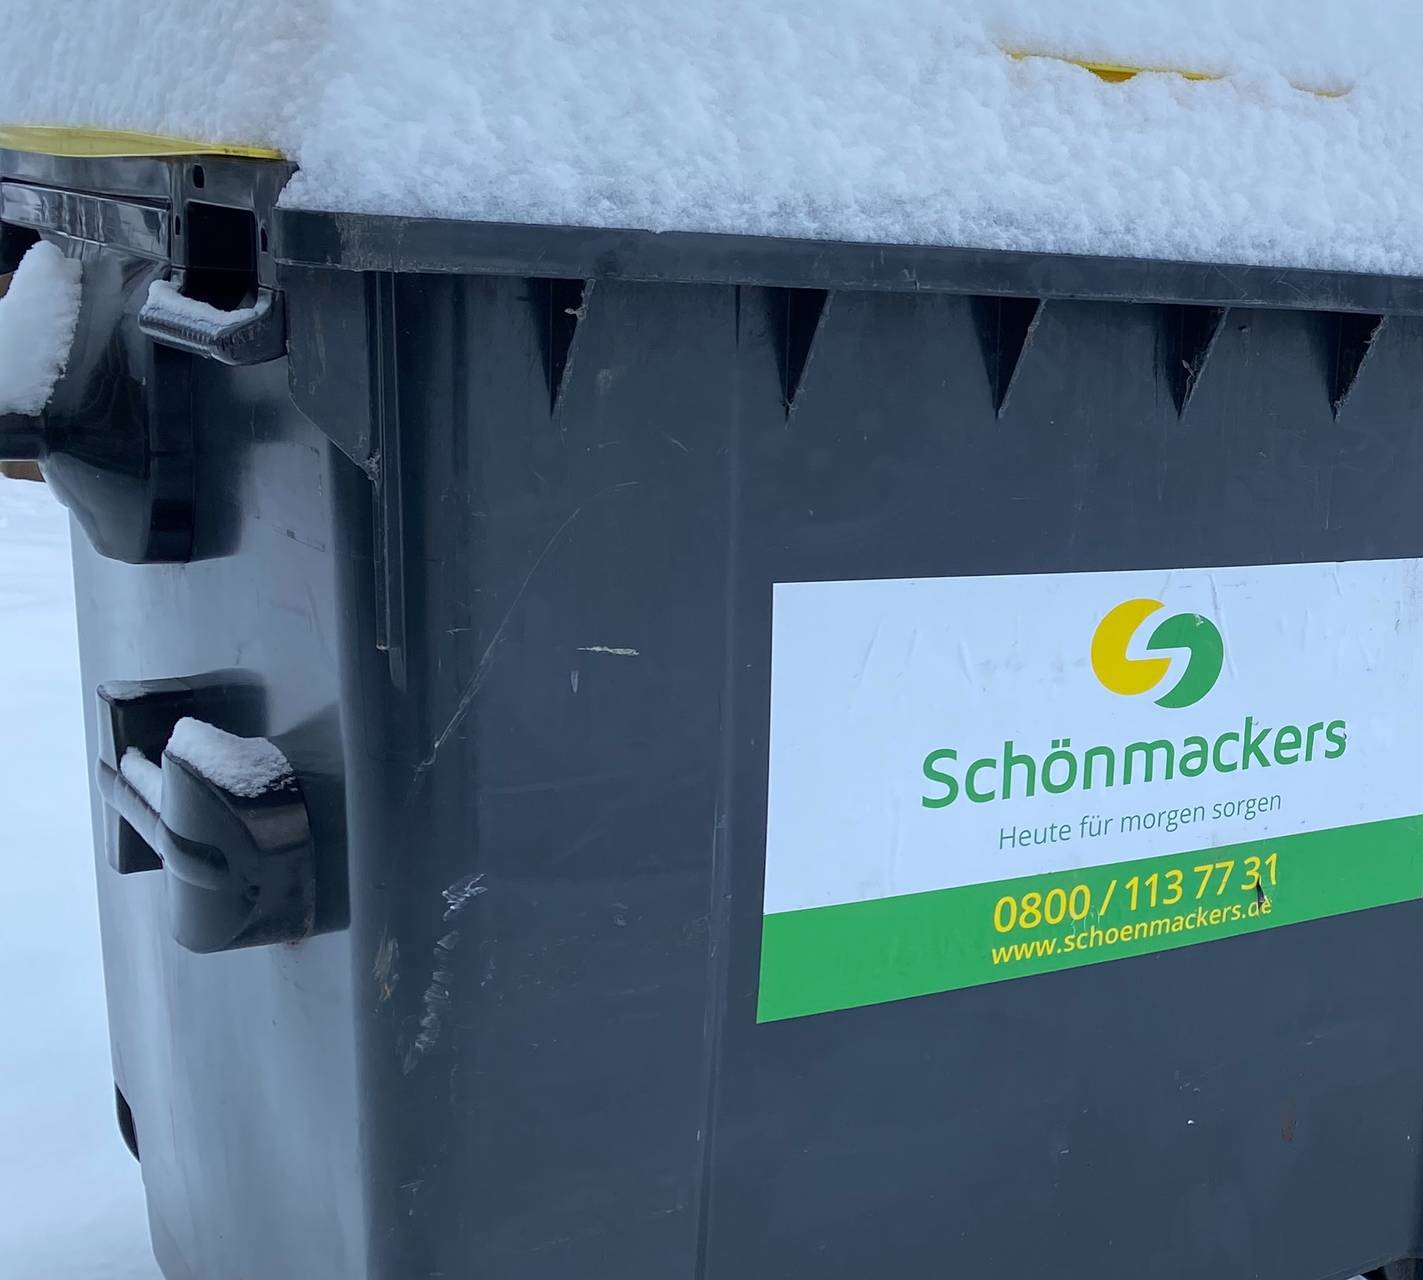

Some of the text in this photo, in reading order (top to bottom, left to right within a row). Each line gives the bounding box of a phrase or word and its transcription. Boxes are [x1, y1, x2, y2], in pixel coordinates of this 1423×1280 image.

[921, 715, 1348, 809] Schönmackers
[999, 791, 1282, 850] Heute für morgen sorgen
[991, 896, 1273, 966] www.schoenmackers.de
[992, 883, 1092, 934] 0800
[1124, 869, 1184, 912] 113
[1193, 860, 1236, 900] 77
[1240, 852, 1279, 892] 31
